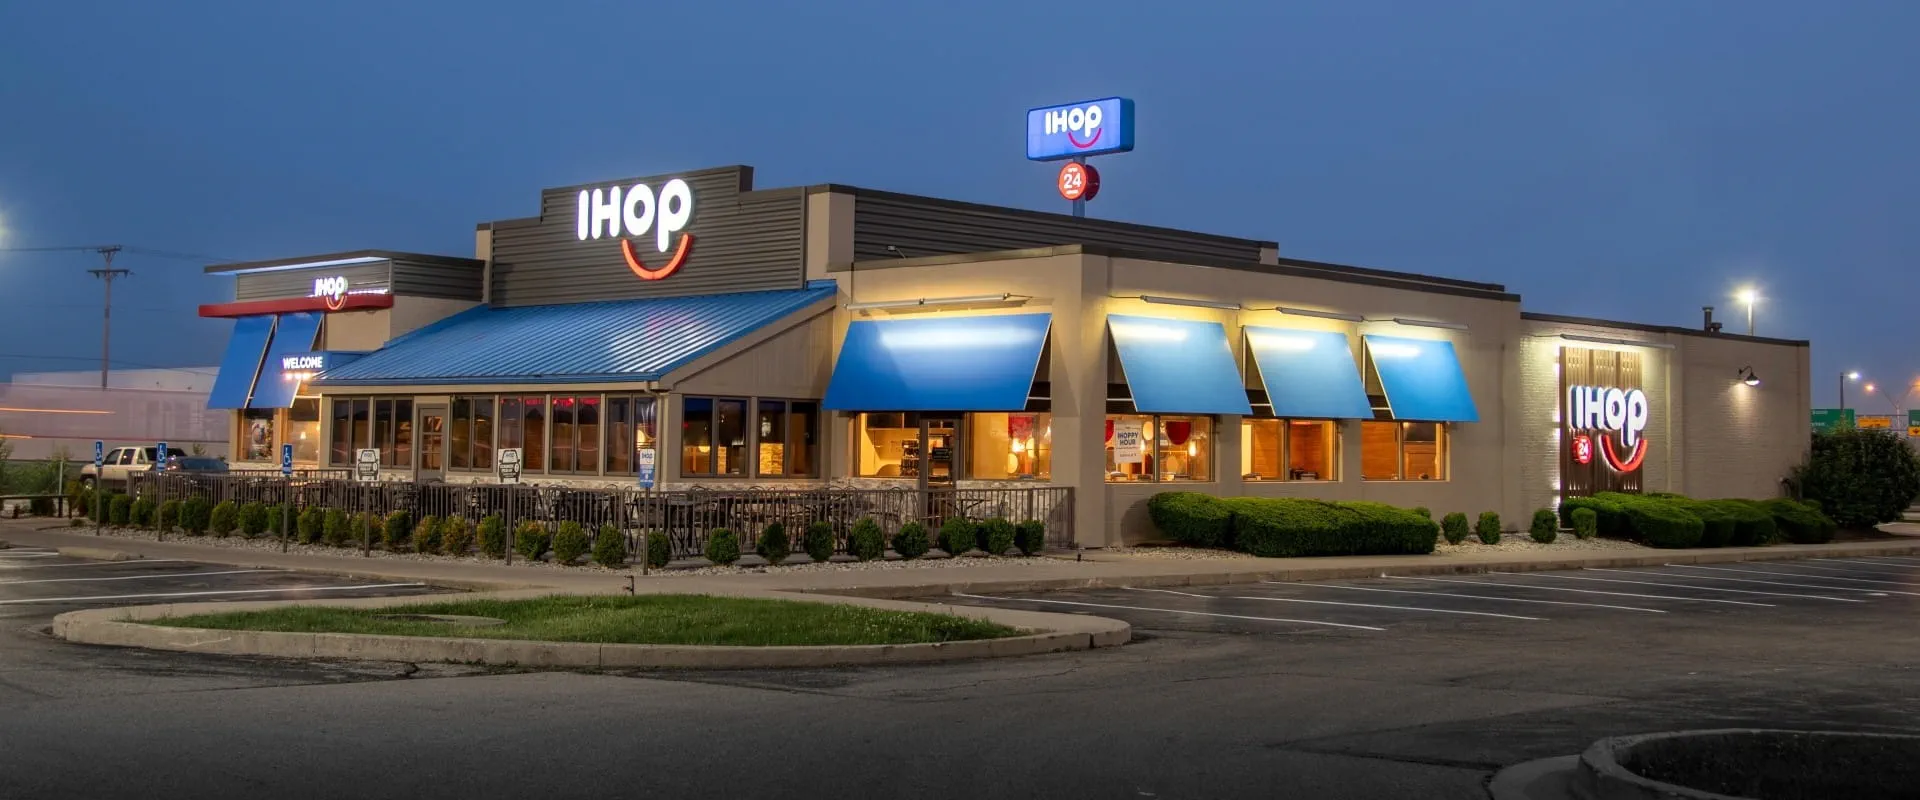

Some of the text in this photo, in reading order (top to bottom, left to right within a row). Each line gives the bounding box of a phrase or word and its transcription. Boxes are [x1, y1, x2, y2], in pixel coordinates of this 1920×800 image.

[1045, 105, 1102, 138] IHOP
[1063, 172, 1082, 189] 24
[577, 179, 692, 253] IHOP
[314, 276, 348, 301] IHOP
[282, 356, 324, 369] WELCOME
[1571, 386, 1648, 447] IHOP
[1577, 442, 1589, 456] 24
